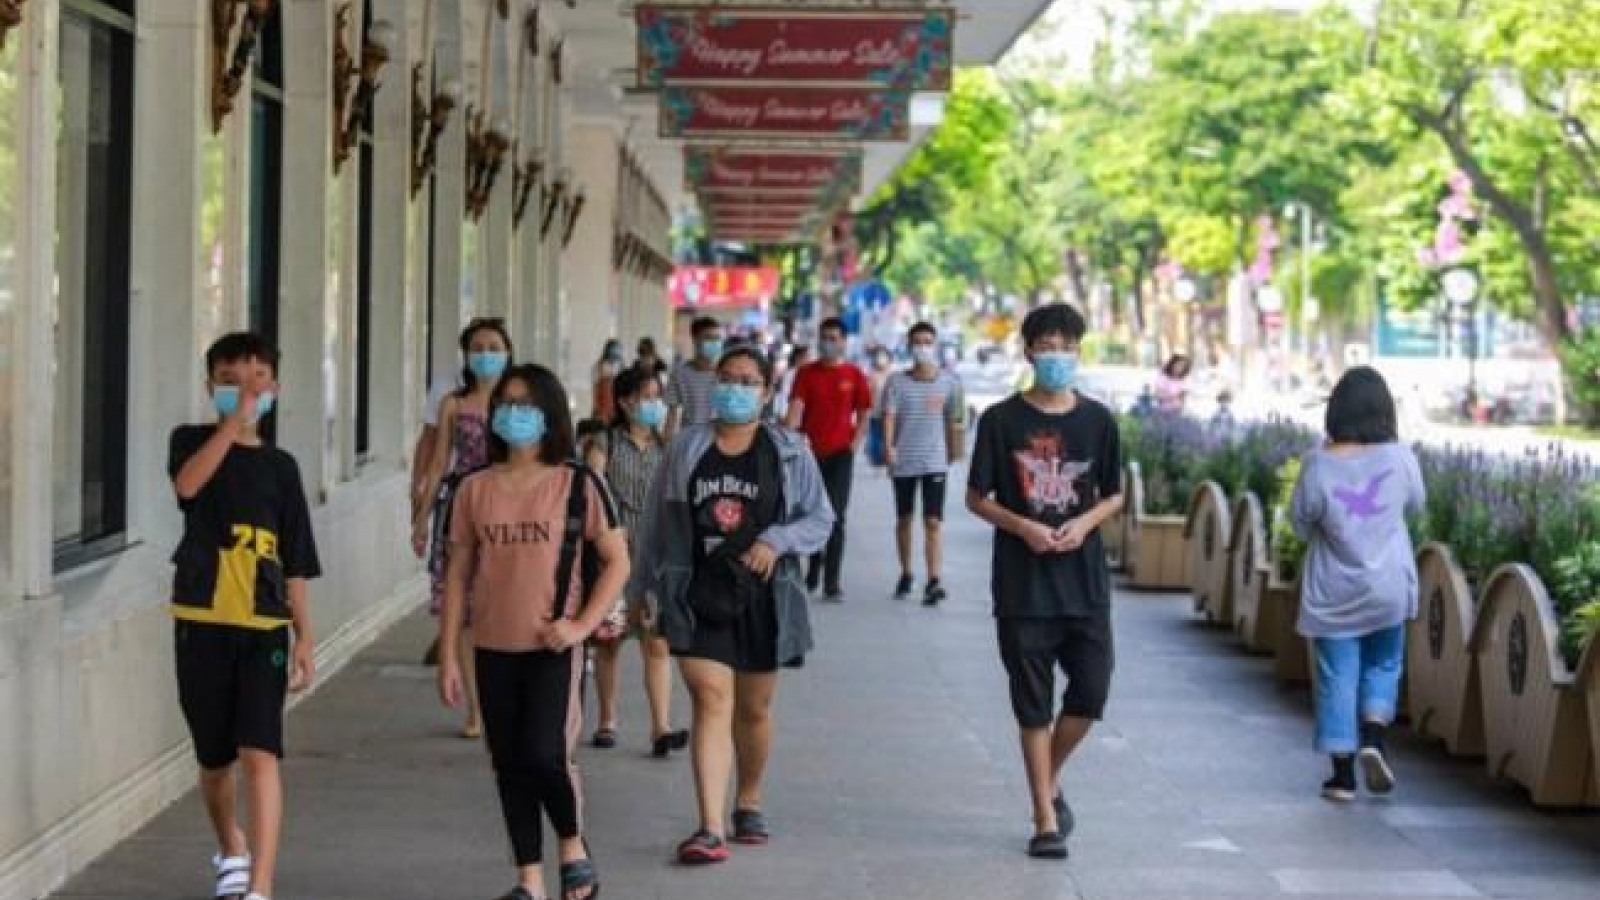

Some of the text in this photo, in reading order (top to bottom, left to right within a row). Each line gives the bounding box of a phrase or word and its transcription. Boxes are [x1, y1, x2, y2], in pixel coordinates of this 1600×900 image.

[690, 37, 901, 74] Happy Summer Sale
